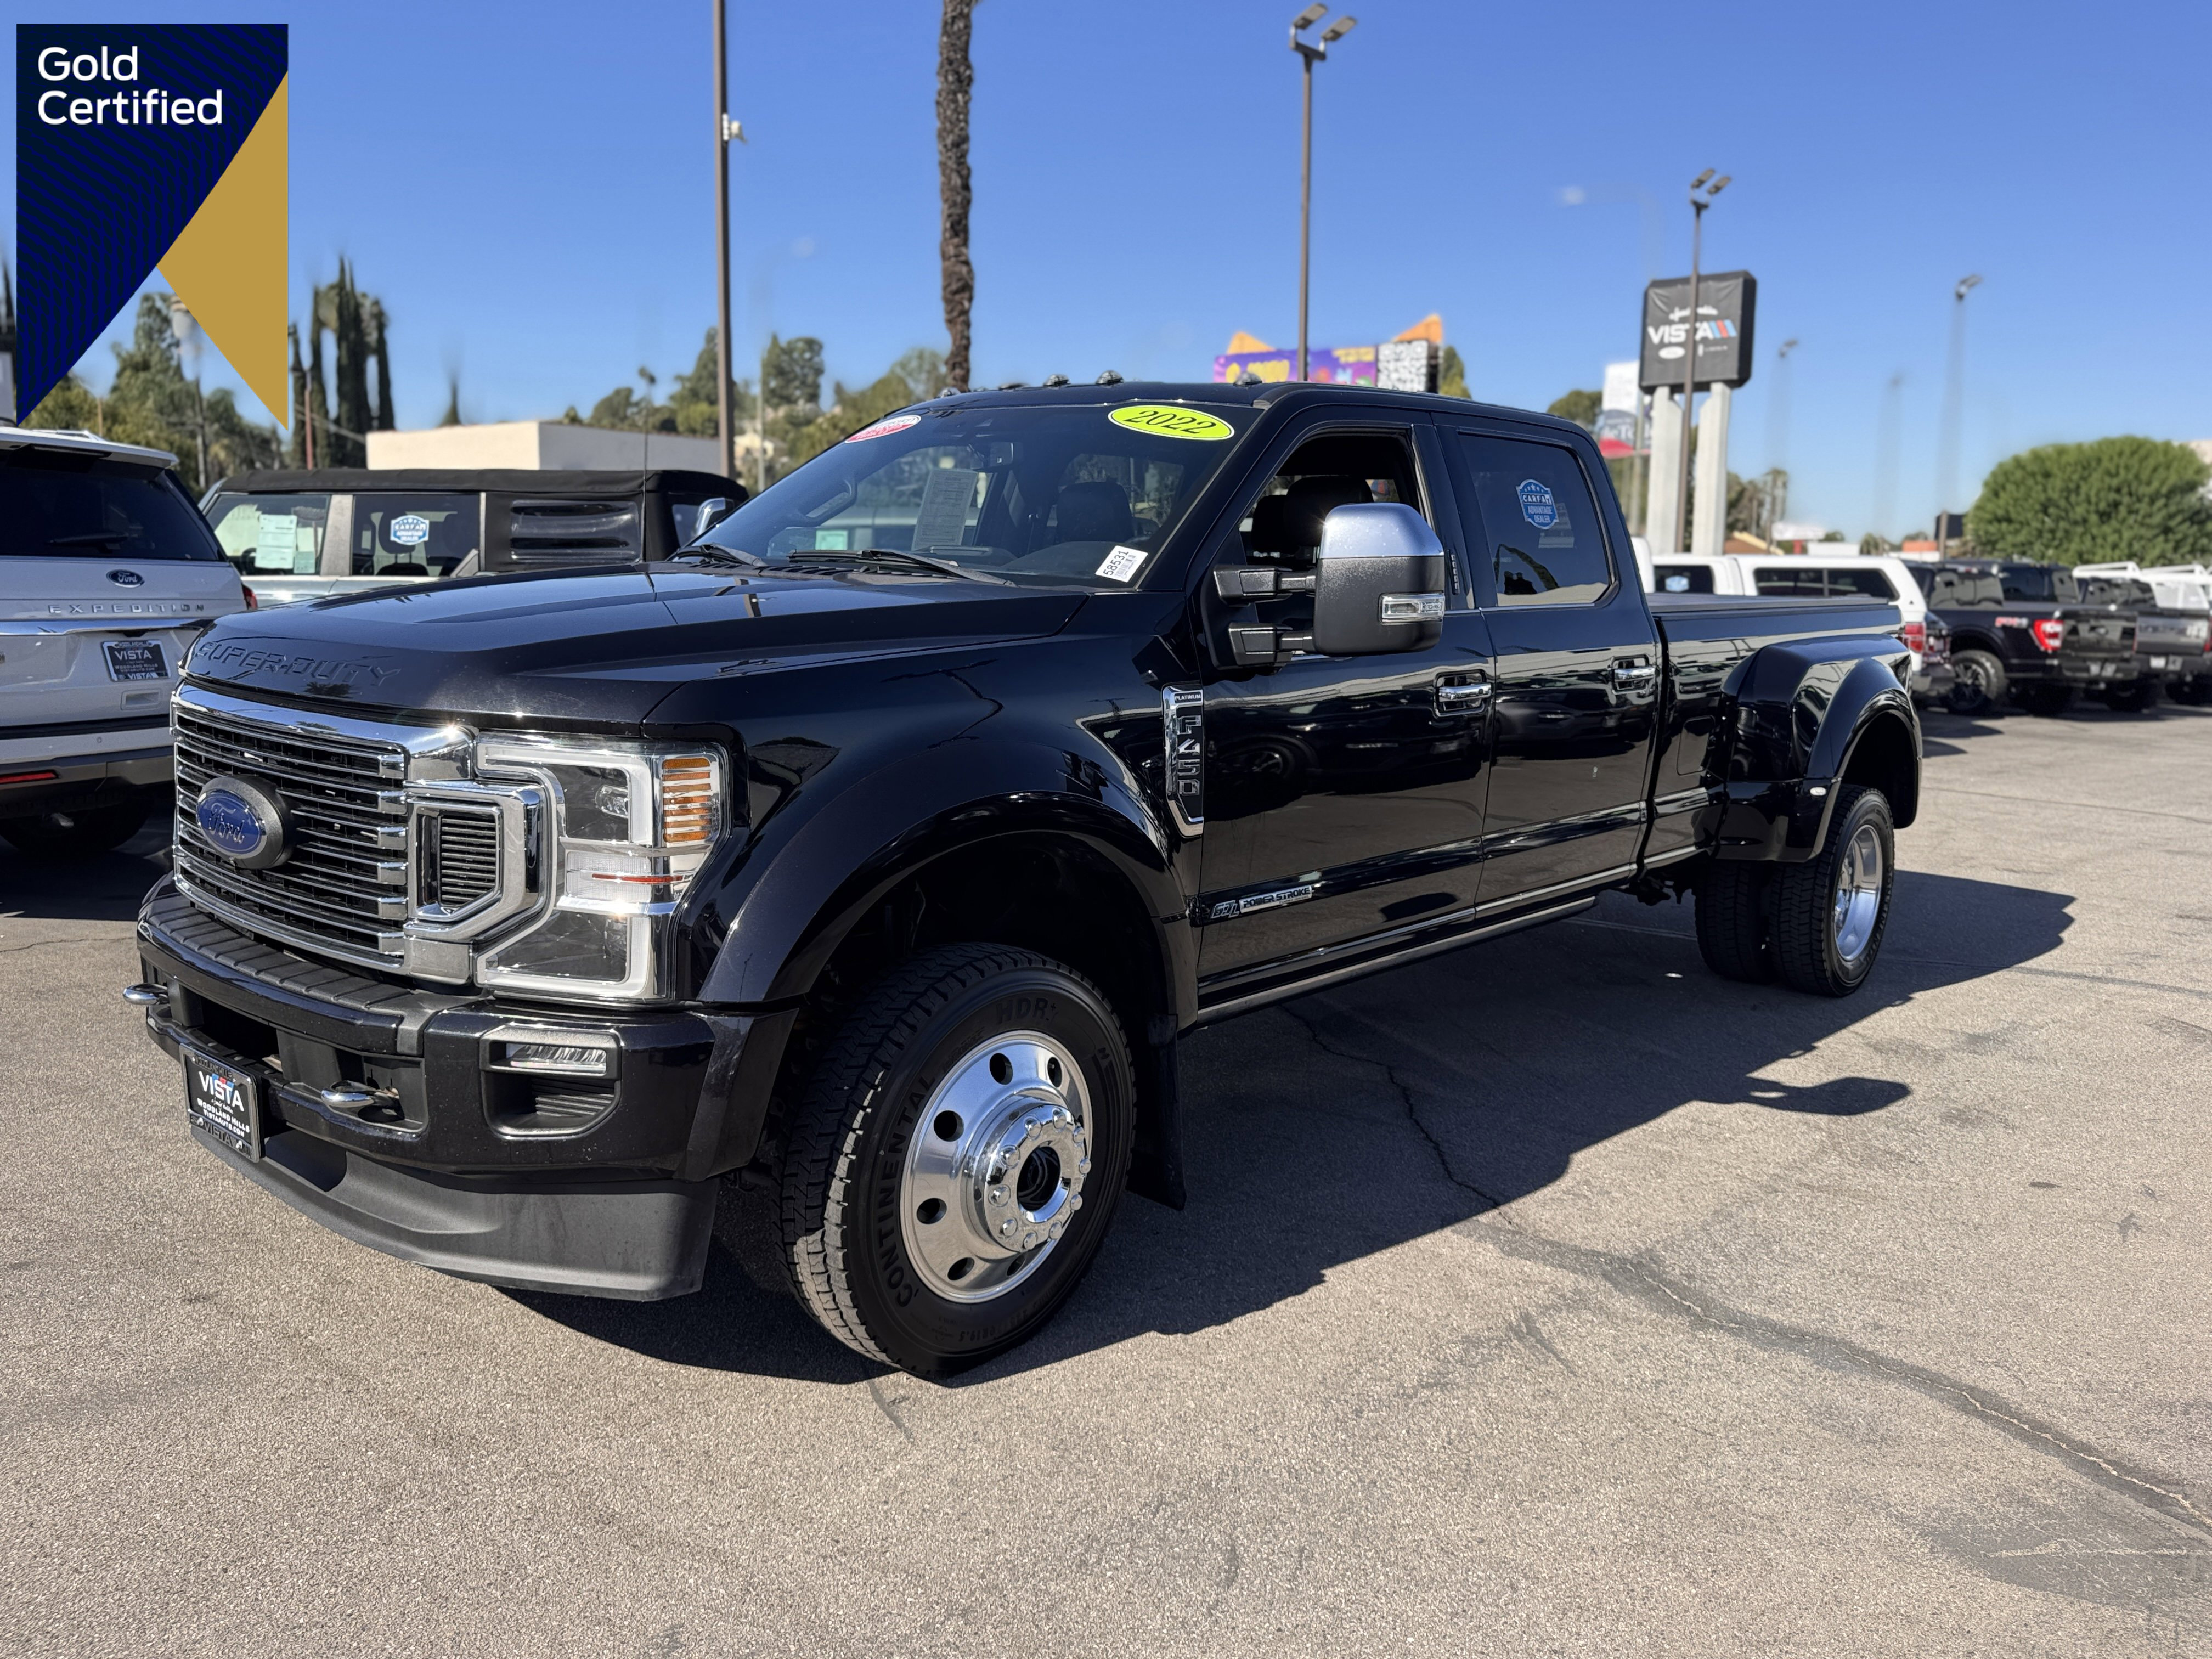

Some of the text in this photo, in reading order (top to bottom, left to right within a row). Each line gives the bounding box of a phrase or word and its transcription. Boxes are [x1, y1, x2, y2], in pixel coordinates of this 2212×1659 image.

[1123, 410, 1217, 434] 2022
[1103, 551, 1129, 575] 58531
[118, 572, 138, 583] Ford
[49, 604, 204, 613] EXPEDITION
[114, 650, 153, 661] VISTA
[195, 641, 401, 687] SUPER DUTY
[208, 803, 245, 844] Ford
[1243, 895, 1274, 909] POWER
[1276, 887, 1310, 902] STROKE
[199, 1071, 244, 1111] VISTA
[197, 1098, 230, 1122] WOODLAND
[232, 1116, 250, 1133] HILLS
[204, 1120, 233, 1147] VISTA
[878, 1076, 935, 1308] CONTINENTAL
